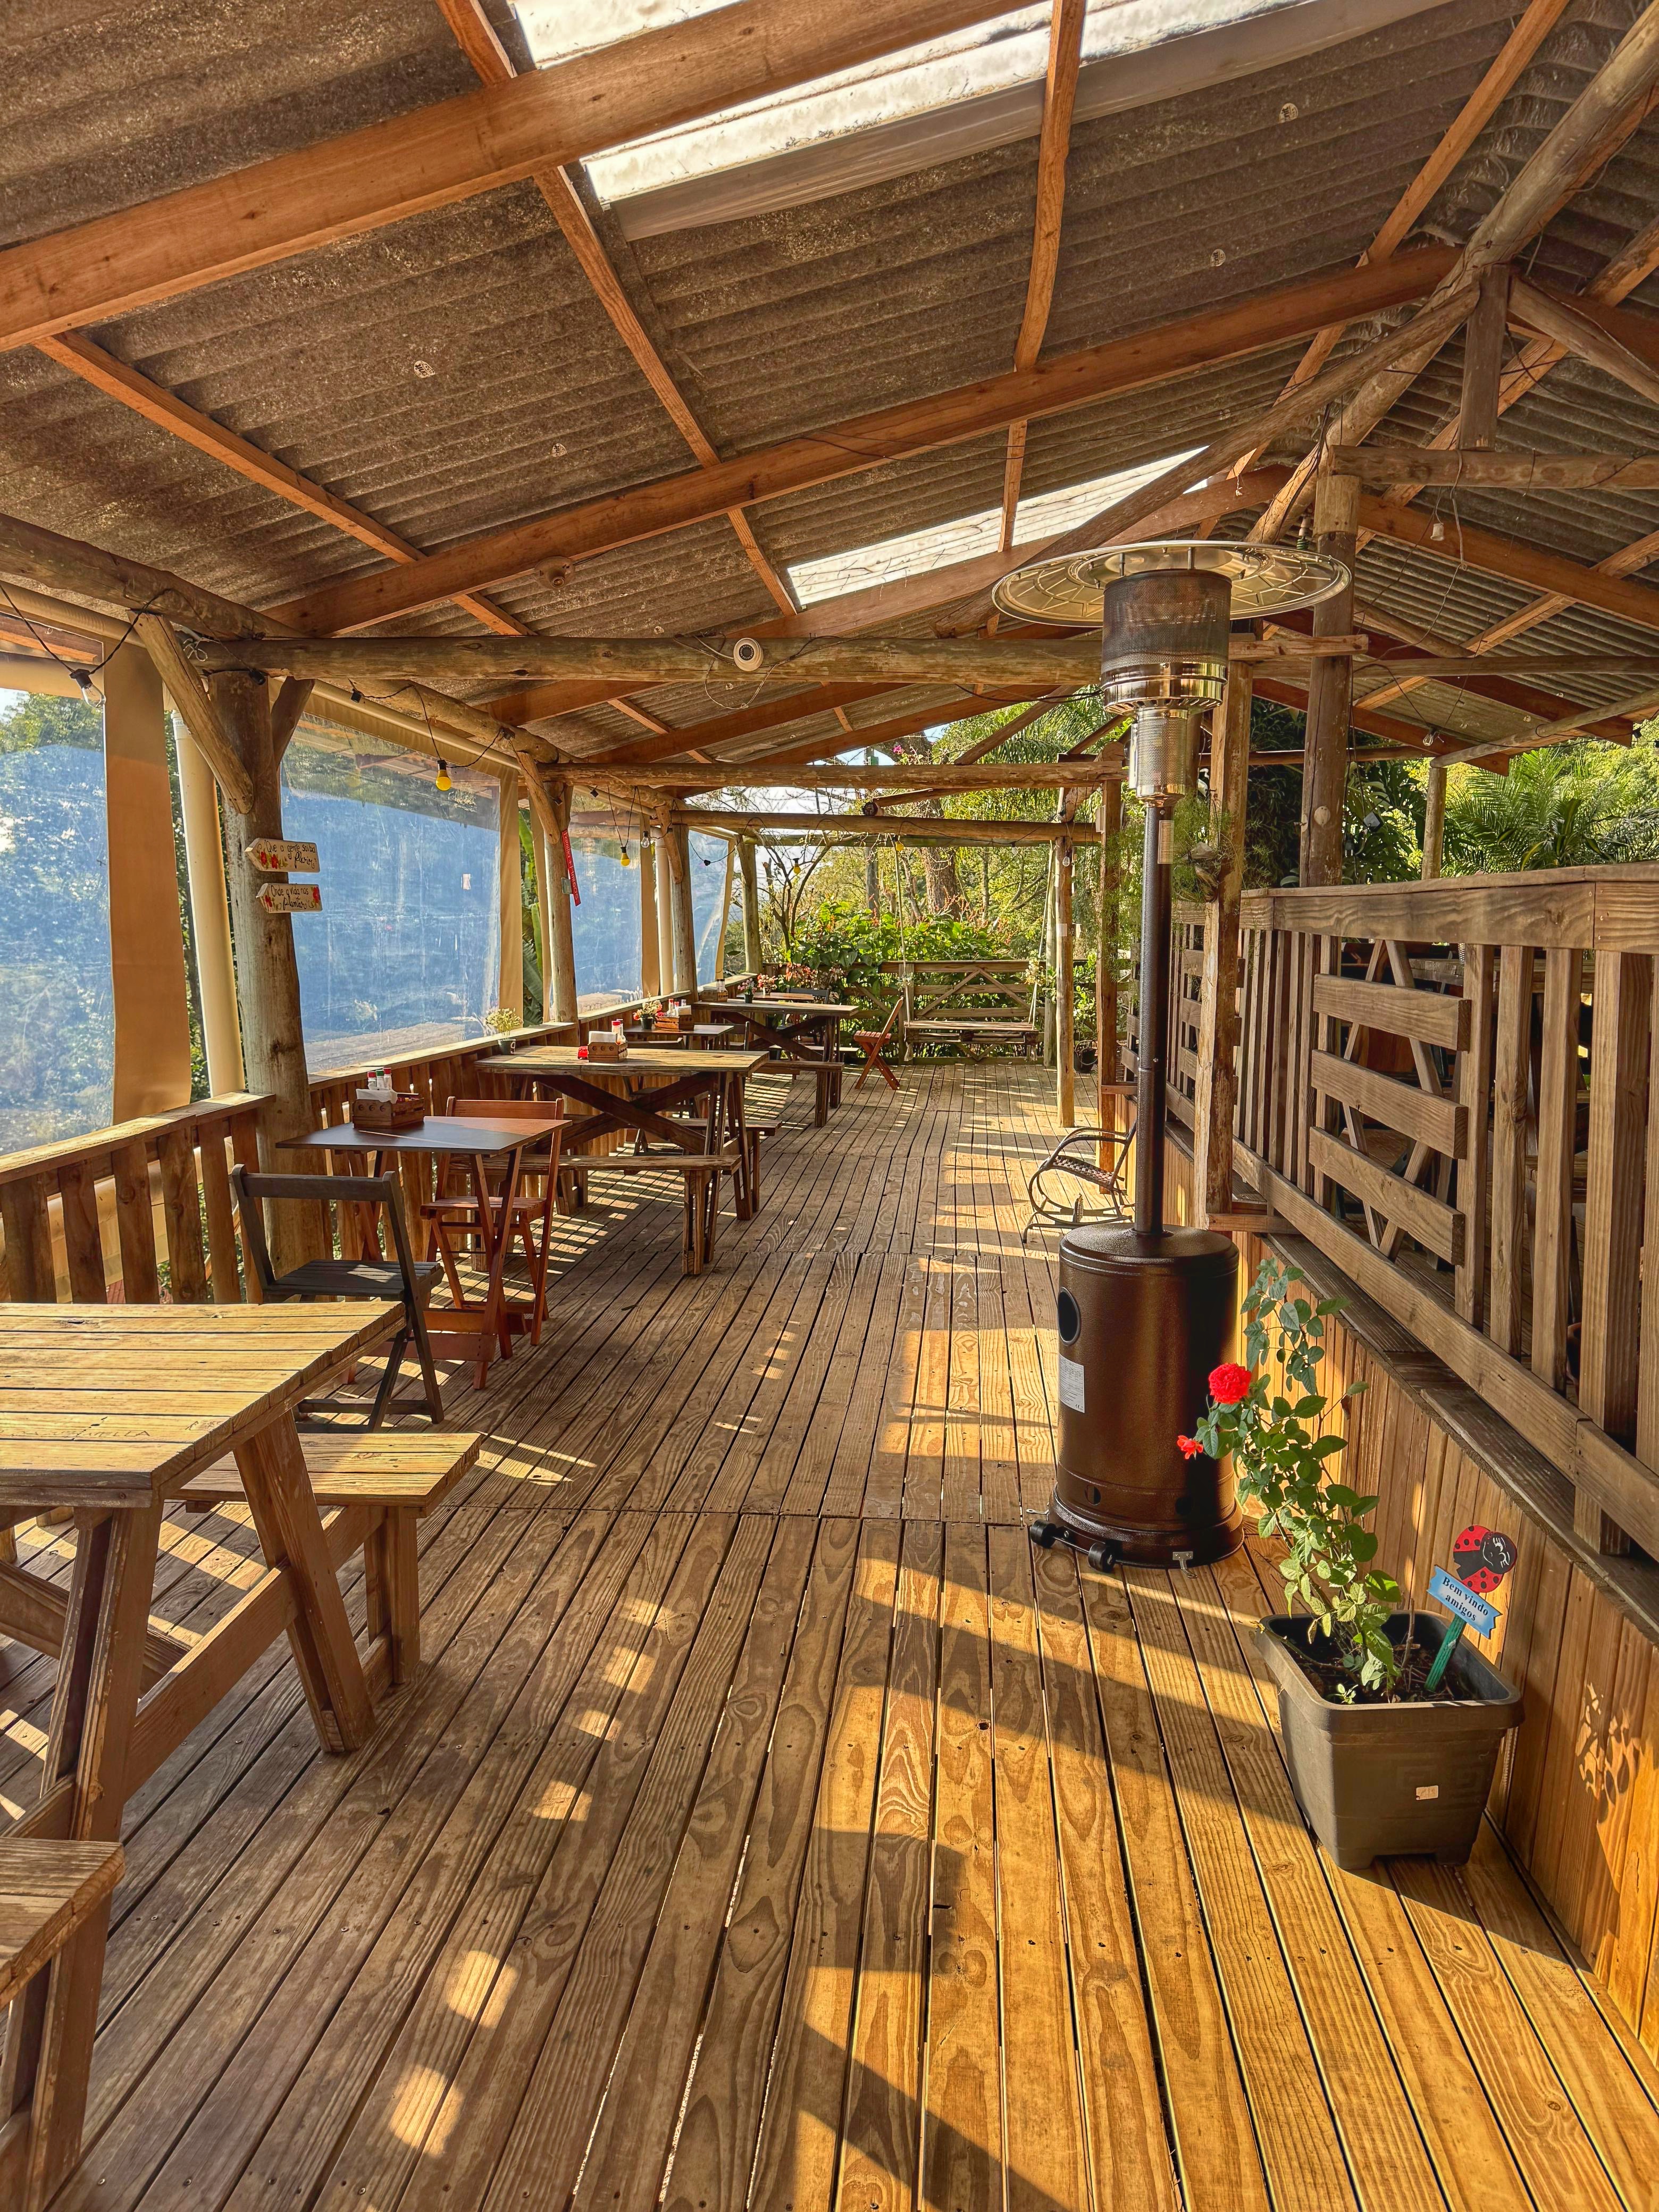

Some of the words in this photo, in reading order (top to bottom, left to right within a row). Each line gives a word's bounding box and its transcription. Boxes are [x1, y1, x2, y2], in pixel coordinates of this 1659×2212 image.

[287, 844, 300, 859] gente
[302, 844, 315, 853] saiba
[271, 885, 284, 896] Onde
[1442, 1577, 1462, 1596] Bem
[1465, 1594, 1488, 1616] vindo
[1445, 1595, 1477, 1621] amigos
